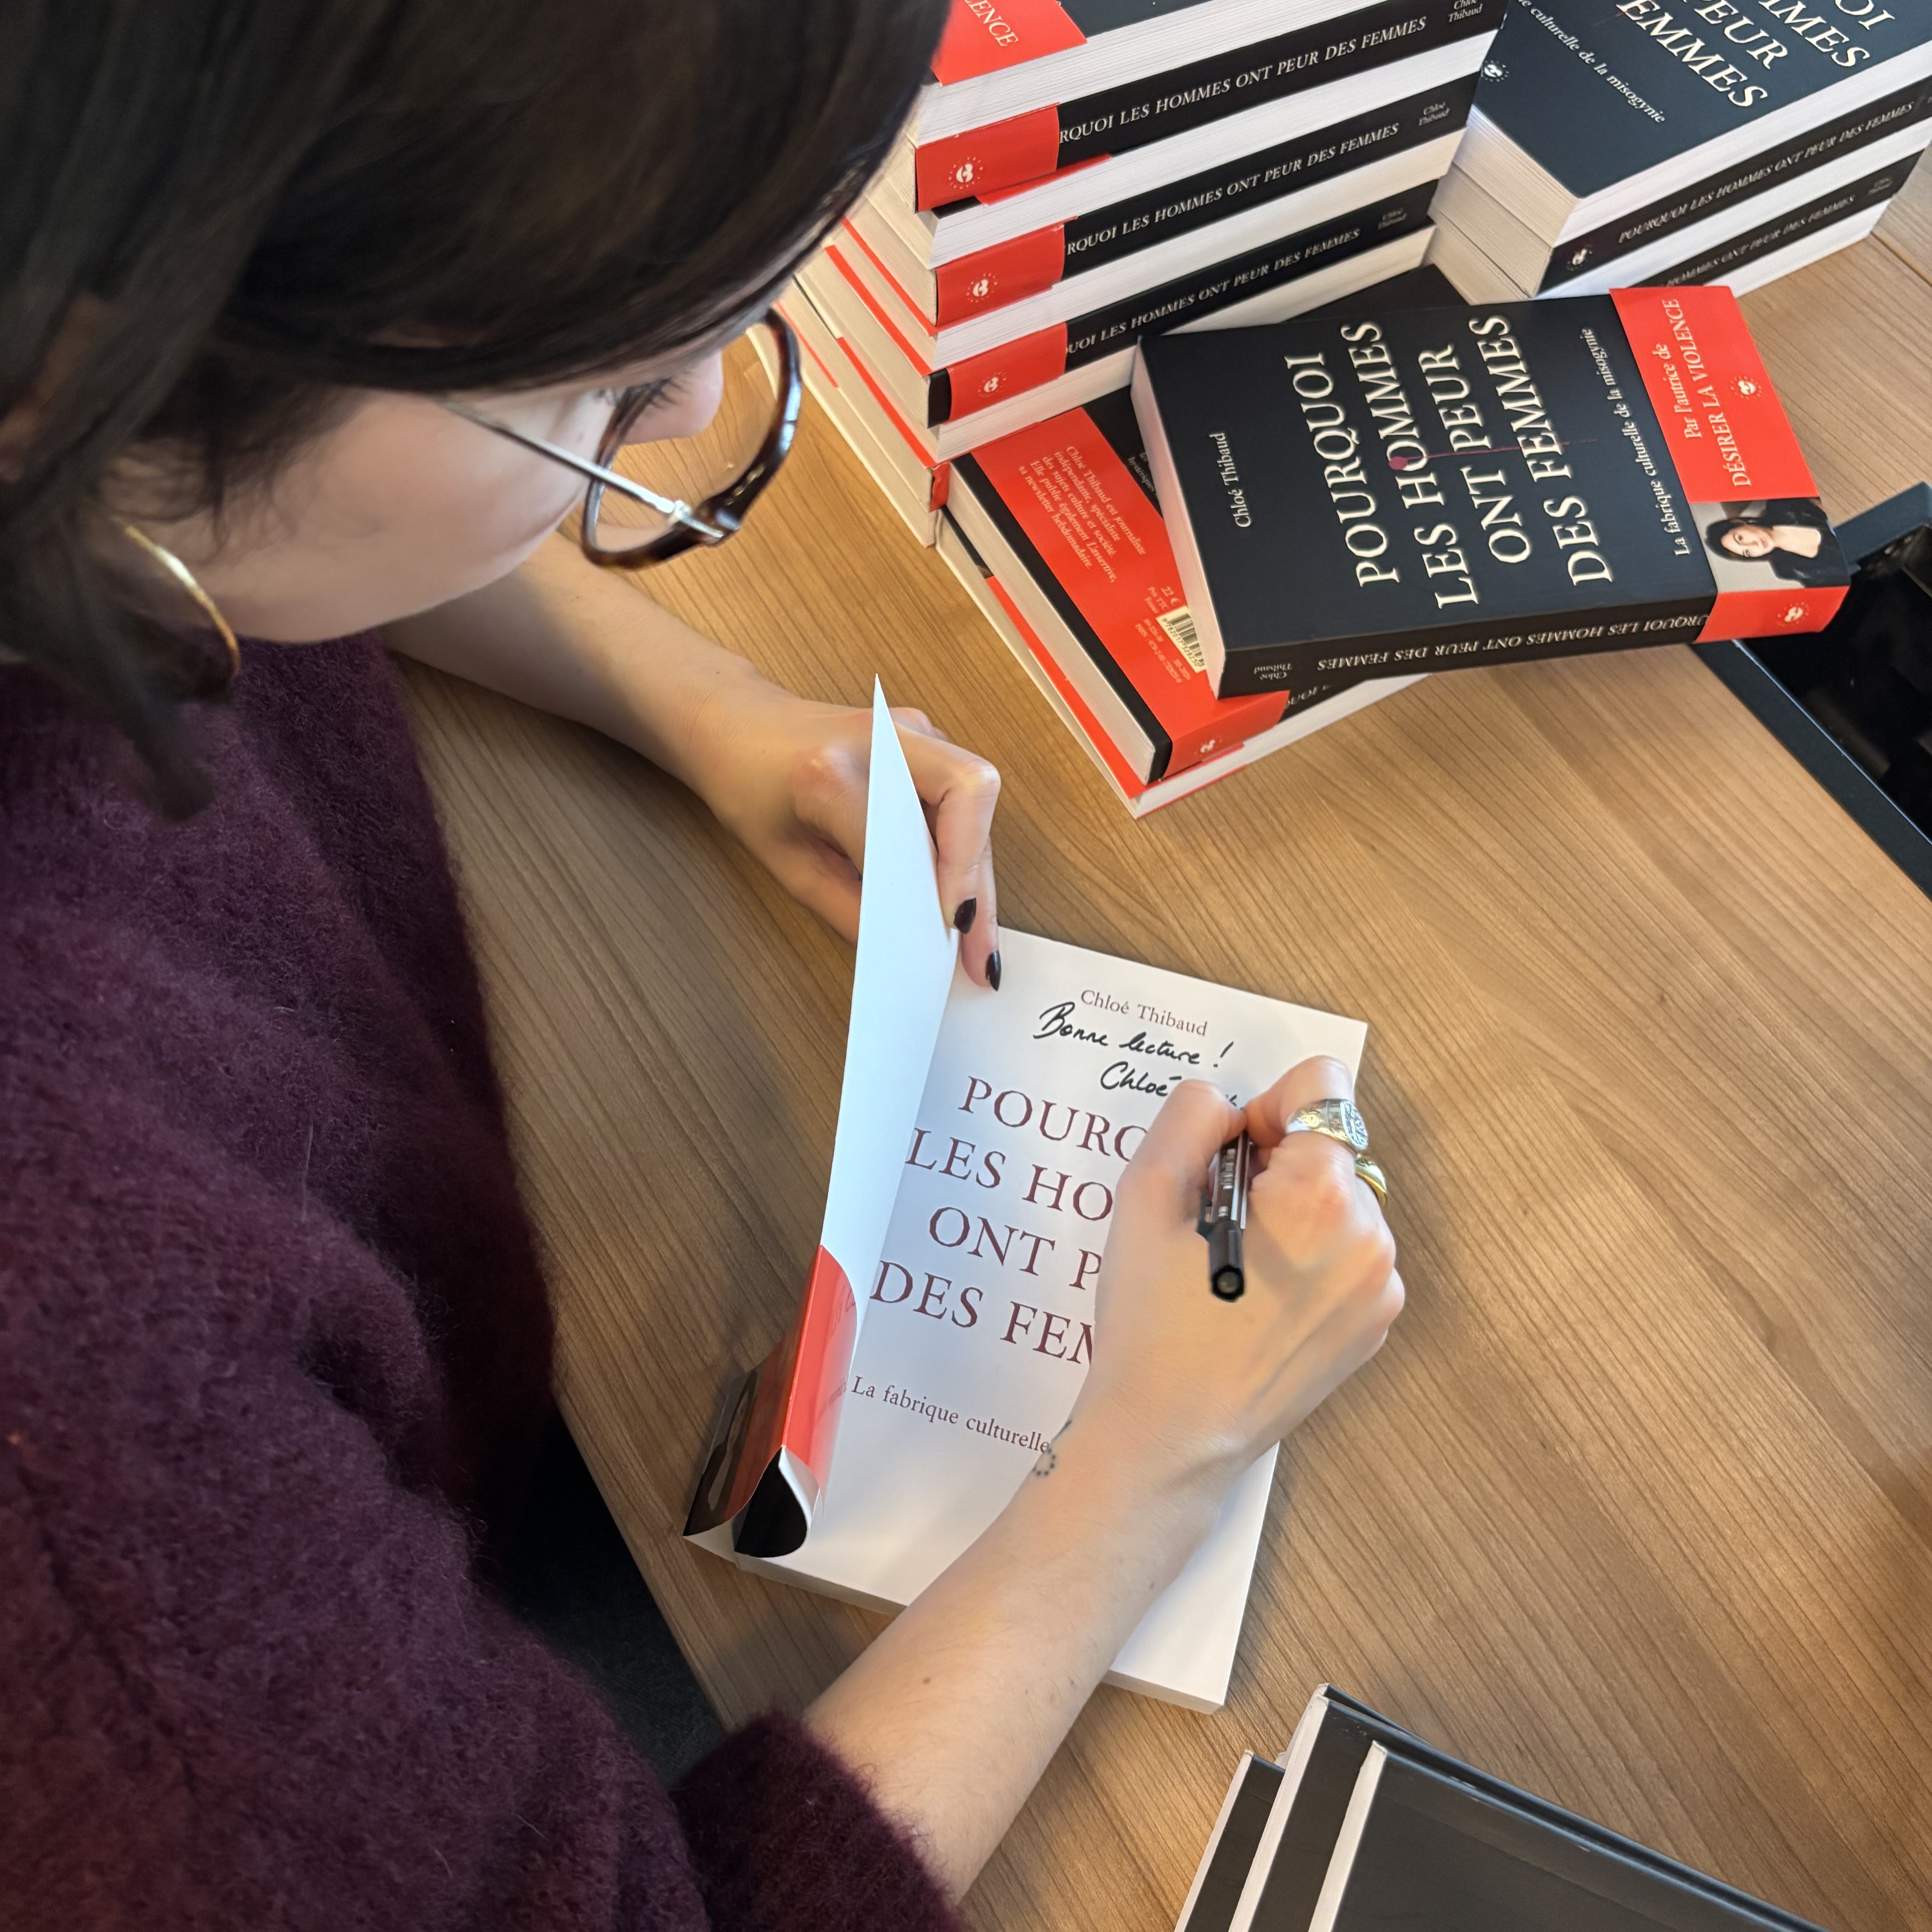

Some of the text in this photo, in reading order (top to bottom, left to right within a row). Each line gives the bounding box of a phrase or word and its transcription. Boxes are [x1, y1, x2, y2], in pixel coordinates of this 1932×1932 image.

[965, 0, 1019, 46] ENCE
[1448, 3, 1483, 22] Thibaud
[1684, 0, 1787, 69] EUR
[1758, 0, 1870, 66] MES
[1835, 0, 1895, 30] OI
[1058, 16, 1426, 144] RQUOI LES HOMMES ONT PEUR DES FEMMES
[1530, 8, 1665, 123] culturelle de la misogynie
[1616, 0, 1768, 106] EMMES
[1066, 122, 1399, 255] RQUOI LES HOMMES ONT PEUR DES FEMMES
[1066, 228, 1360, 354] UOI LES HOMMES ONT PEUR DES FEMMES
[1651, 343, 1671, 359] de
[1661, 299, 1751, 486] DÉSIRER LA VIOLENCE
[1418, 345, 1531, 563] ONT PEUR
[1468, 316, 1613, 586] DES FEMMES
[1579, 328, 1690, 555] La fabrique culturelle de la misogynie
[1684, 416, 1702, 438] Par
[1209, 432, 1251, 527] Chloé Thibaud
[1284, 353, 1400, 587] POURQUOI
[1340, 323, 1479, 609] LES HOMMES
[1317, 652, 1388, 671] FEMMES
[1394, 647, 1428, 661] DES
[1434, 640, 1478, 656] PEUR
[1482, 635, 1522, 650] ONT
[1526, 625, 1603, 645] HOMMES
[1607, 621, 1639, 635] LES
[1033, 1002, 1109, 1046] Bonne
[1118, 1031, 1200, 1065] lecture
[1081, 989, 1208, 1036] Chloé Thibaud
[1100, 1061, 1182, 1097] Chloé
[905, 1127, 1113, 1221] LES HO
[929, 1206, 1102, 1290] ONT P
[869, 1260, 984, 1328] DES
[851, 1375, 875, 1398] La
[882, 1385, 959, 1424] fabrique
[966, 1418, 1050, 1453] culturelle
